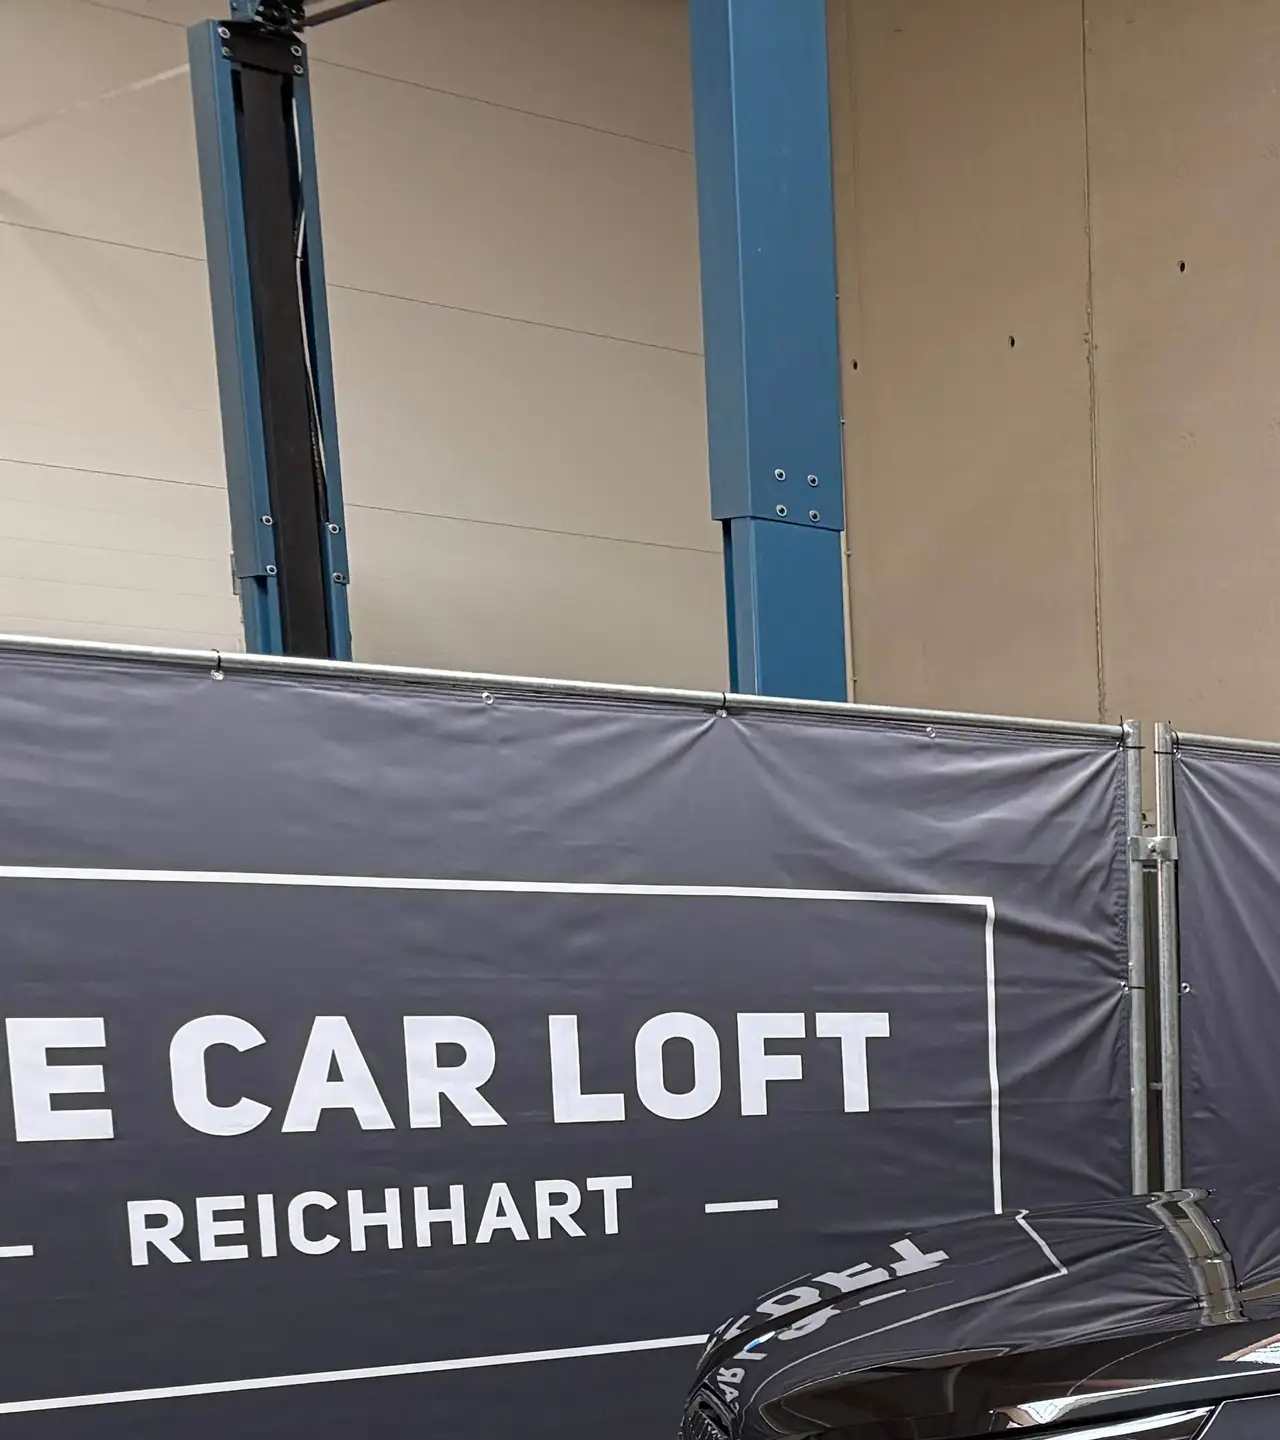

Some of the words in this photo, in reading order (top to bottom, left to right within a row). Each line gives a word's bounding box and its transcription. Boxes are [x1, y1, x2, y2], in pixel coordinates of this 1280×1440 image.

[169, 1014, 508, 1136] CAR
[548, 1011, 890, 1124] LOFT
[126, 1175, 633, 1266] REICHHART
